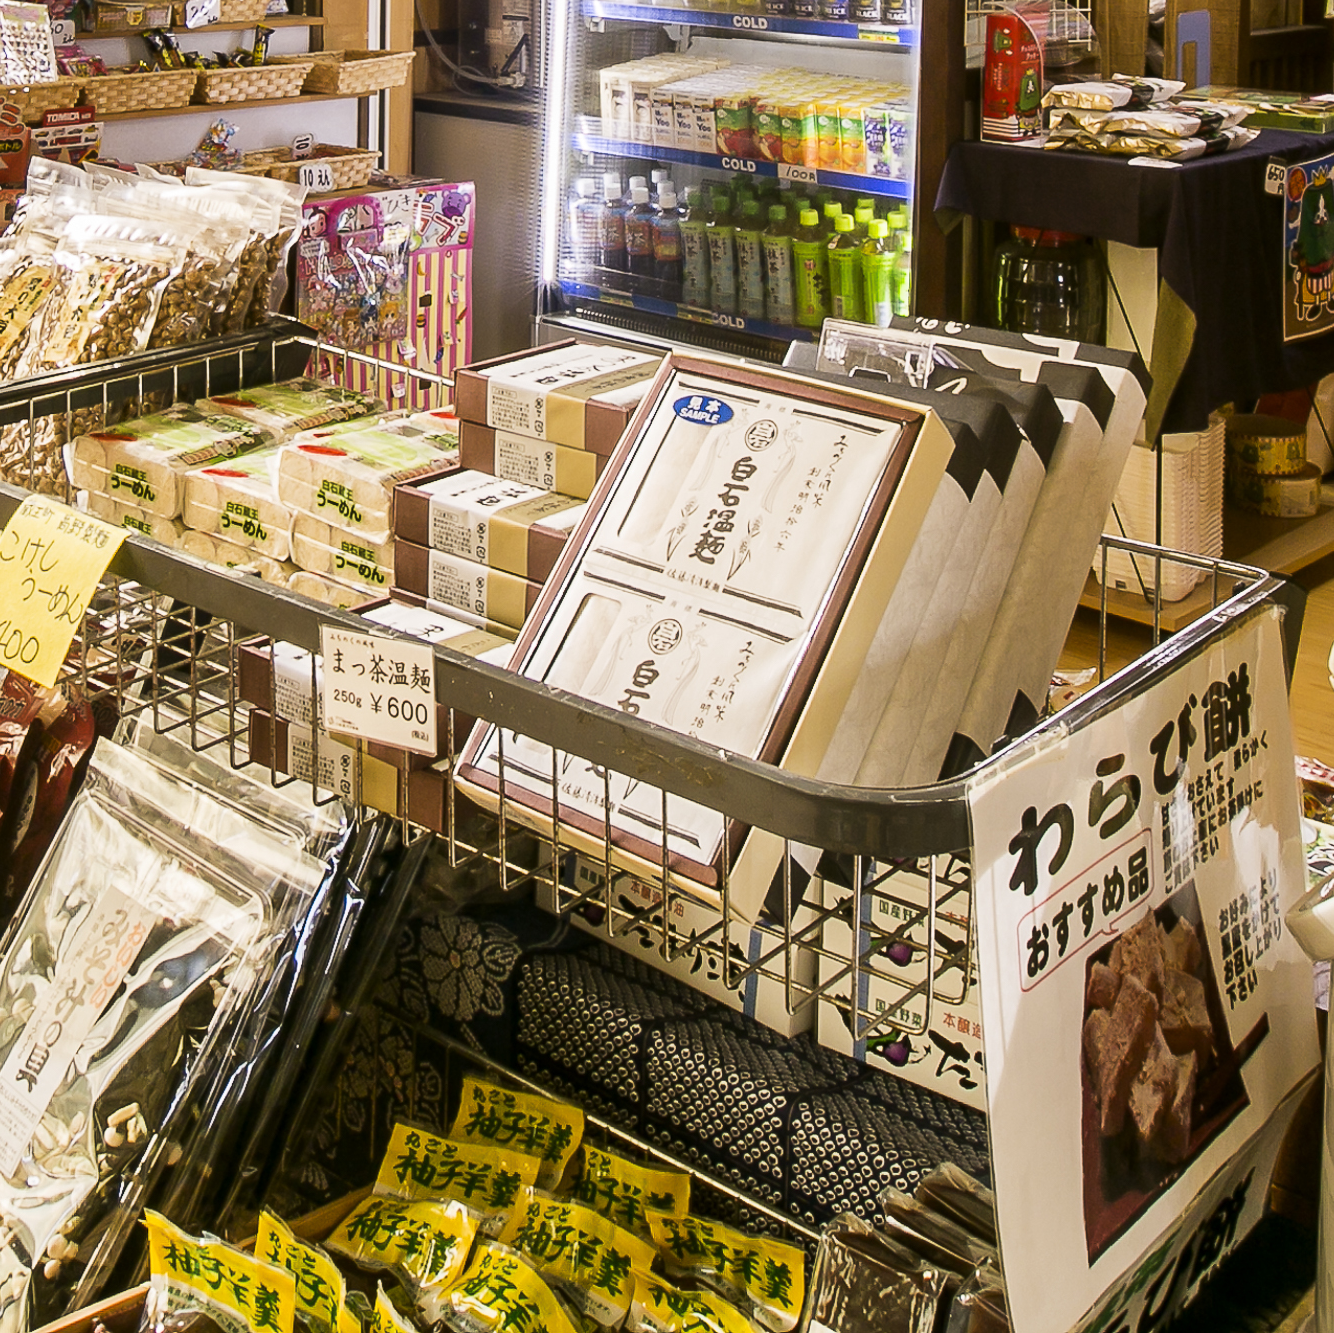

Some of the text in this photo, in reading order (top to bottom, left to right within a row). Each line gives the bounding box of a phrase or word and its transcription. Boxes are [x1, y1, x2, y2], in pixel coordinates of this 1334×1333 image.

[732, 16, 768, 29] COLD
[46, 111, 81, 123] TOMICA
[721, 156, 757, 173] COLD
[679, 406, 721, 425] SAMPLE
[687, 395, 723, 414] 見本
[109, 474, 156, 503] うーめん
[316, 491, 363, 523] うーめん
[688, 455, 758, 566] 白石温麺
[221, 513, 268, 542] うーめん
[335, 553, 386, 586] うーめん
[332, 647, 432, 696] まっ茶温麺
[617, 659, 660, 716] 白石
[332, 689, 430, 727] 250g ¥600
[1009, 661, 1255, 898] わらび餅
[1025, 845, 1151, 979] おすすめ品
